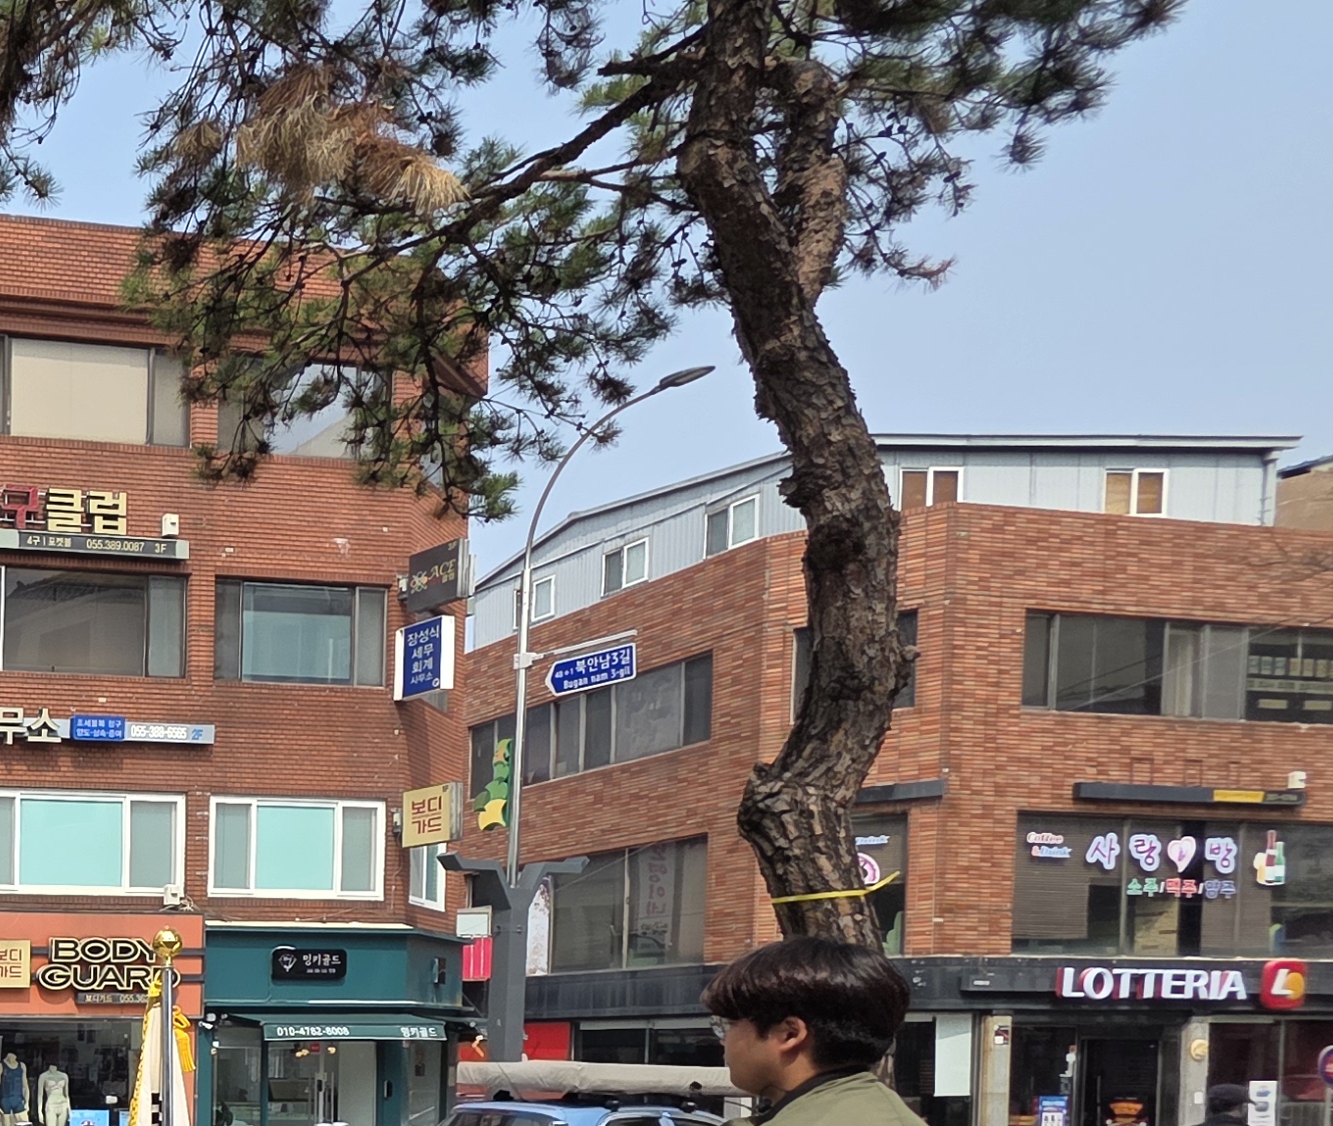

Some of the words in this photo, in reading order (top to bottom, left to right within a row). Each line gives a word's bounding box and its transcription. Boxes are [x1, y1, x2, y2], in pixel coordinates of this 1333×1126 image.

[154, 542, 167, 553] 3F
[428, 558, 457, 581] ACE
[407, 624, 440, 647] 장성식
[412, 643, 434, 659] 세무
[411, 658, 433, 674] 회계
[575, 647, 630, 675] 북안남3길
[410, 671, 433, 685] 사무소
[191, 728, 204, 740] 2F
[411, 796, 442, 815] 보디
[411, 816, 442, 834] 가드
[49, 937, 157, 963] BODY
[302, 953, 342, 967] 밍키골드
[1058, 966, 1248, 1000] LOTTERIA
